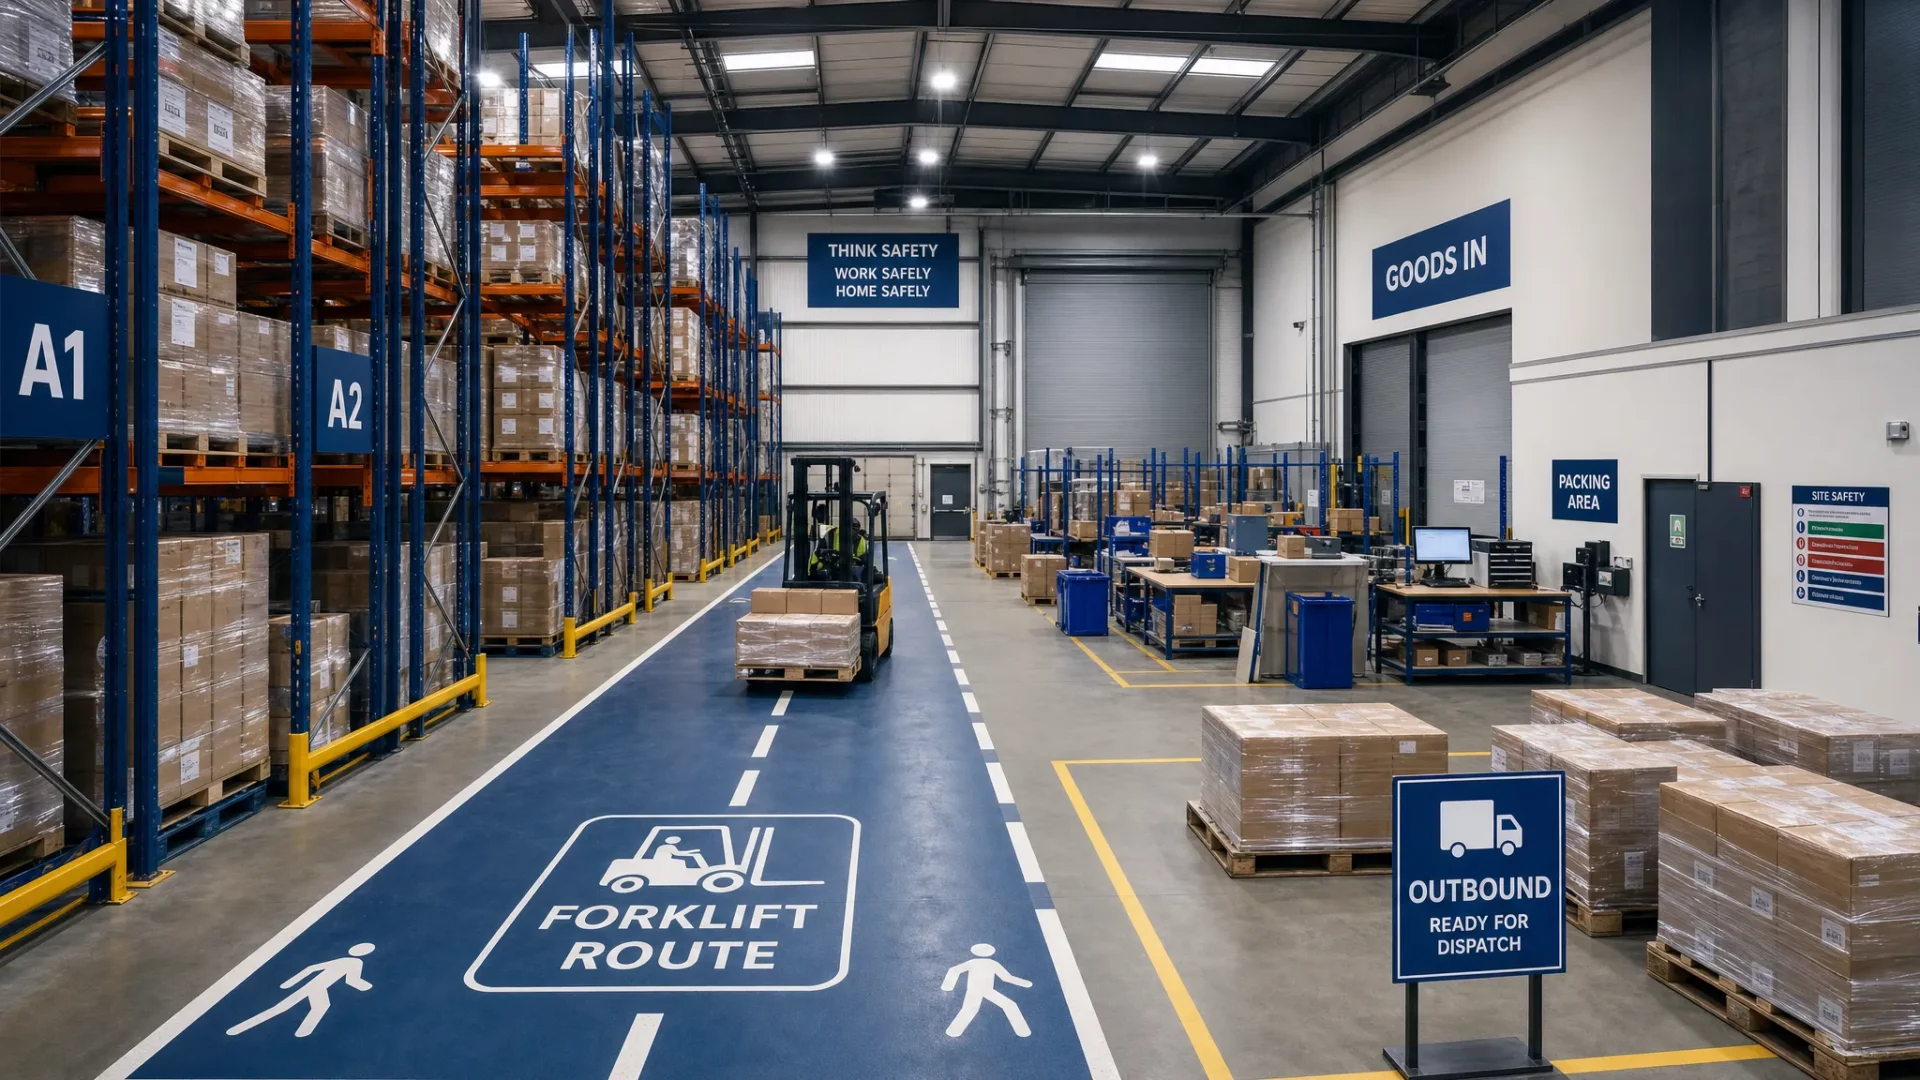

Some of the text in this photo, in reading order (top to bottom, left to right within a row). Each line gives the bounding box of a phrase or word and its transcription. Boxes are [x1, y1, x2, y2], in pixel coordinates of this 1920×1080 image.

[828, 244, 938, 257] THINK SAFETY
[1386, 235, 1486, 291] GOODS IN
[835, 268, 931, 280] WORK SAFELY
[836, 285, 931, 297] HOME SAFELY
[19, 323, 84, 400] A1
[328, 379, 362, 430] A2
[1559, 474, 1610, 490] PACKING
[1567, 494, 1600, 510] AREA
[1811, 491, 1865, 502] SITE SAFETY
[1409, 876, 1552, 904] OUTBOUND
[538, 905, 818, 930] FORKLIFT
[1430, 913, 1529, 933] READY FOR
[1438, 936, 1521, 955] DISPATCH
[560, 941, 778, 970] ROUTE
